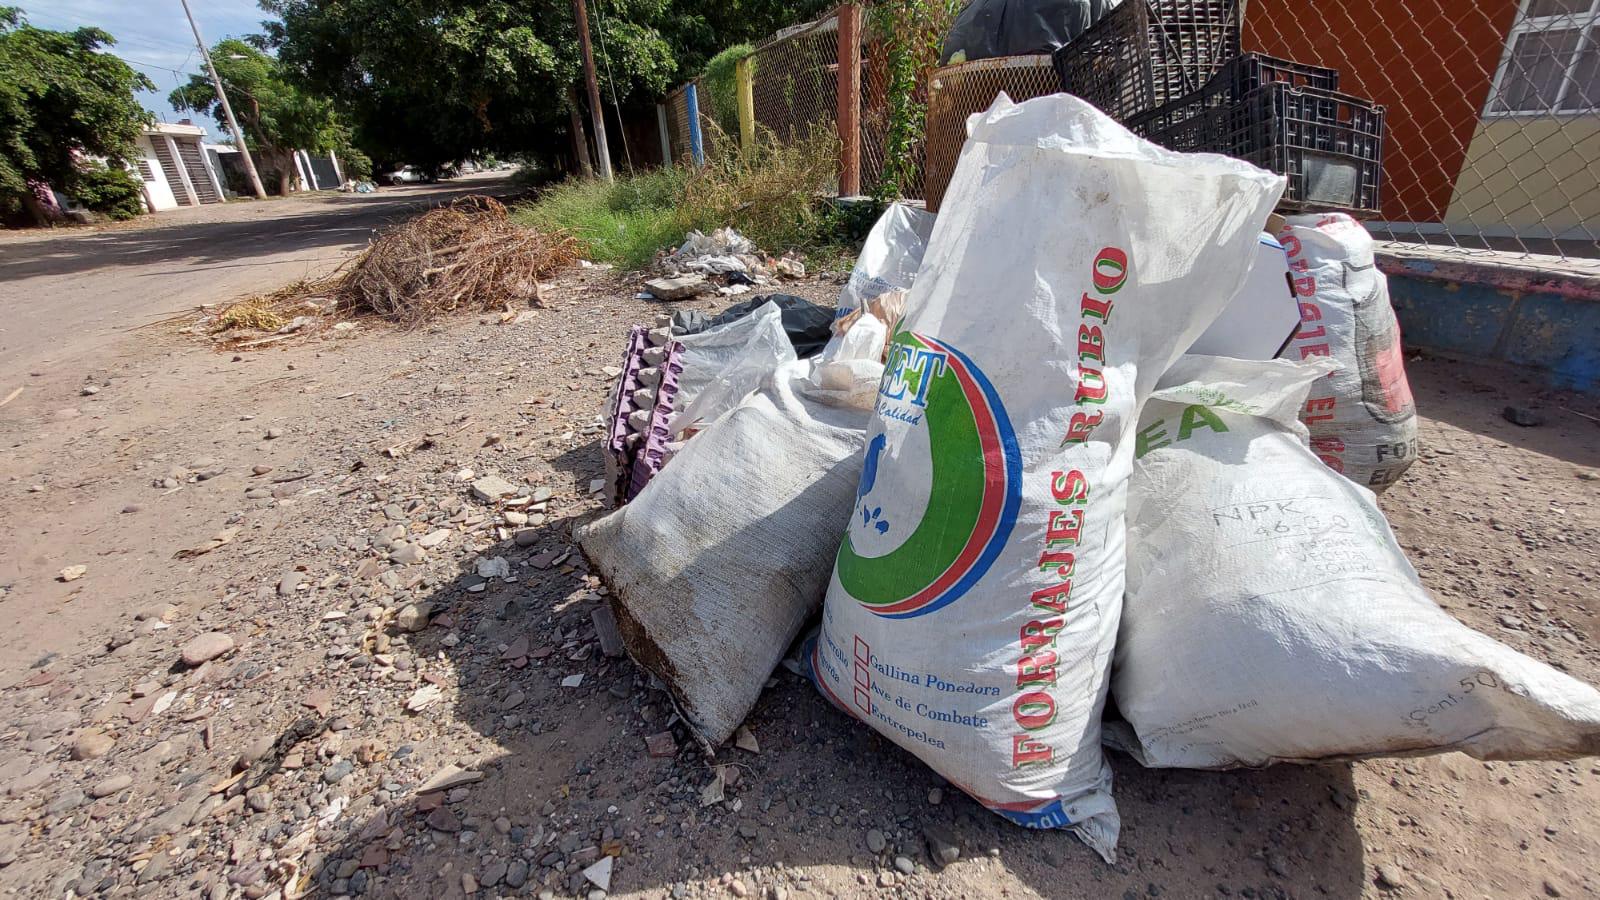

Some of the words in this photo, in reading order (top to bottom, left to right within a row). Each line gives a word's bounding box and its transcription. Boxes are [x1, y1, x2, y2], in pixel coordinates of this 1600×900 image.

[879, 402, 922, 425] Calidad
[1012, 469, 1090, 769] FORRAJES
[1060, 247, 1129, 448] RUBIO
[1213, 500, 1304, 526] NPK
[870, 654, 919, 685] Gallina
[927, 674, 1001, 696] Ponedora
[871, 680, 891, 701] Ave
[895, 696, 912, 711] de
[916, 703, 988, 728] Combate
[871, 704, 946, 750] Entrepelea
